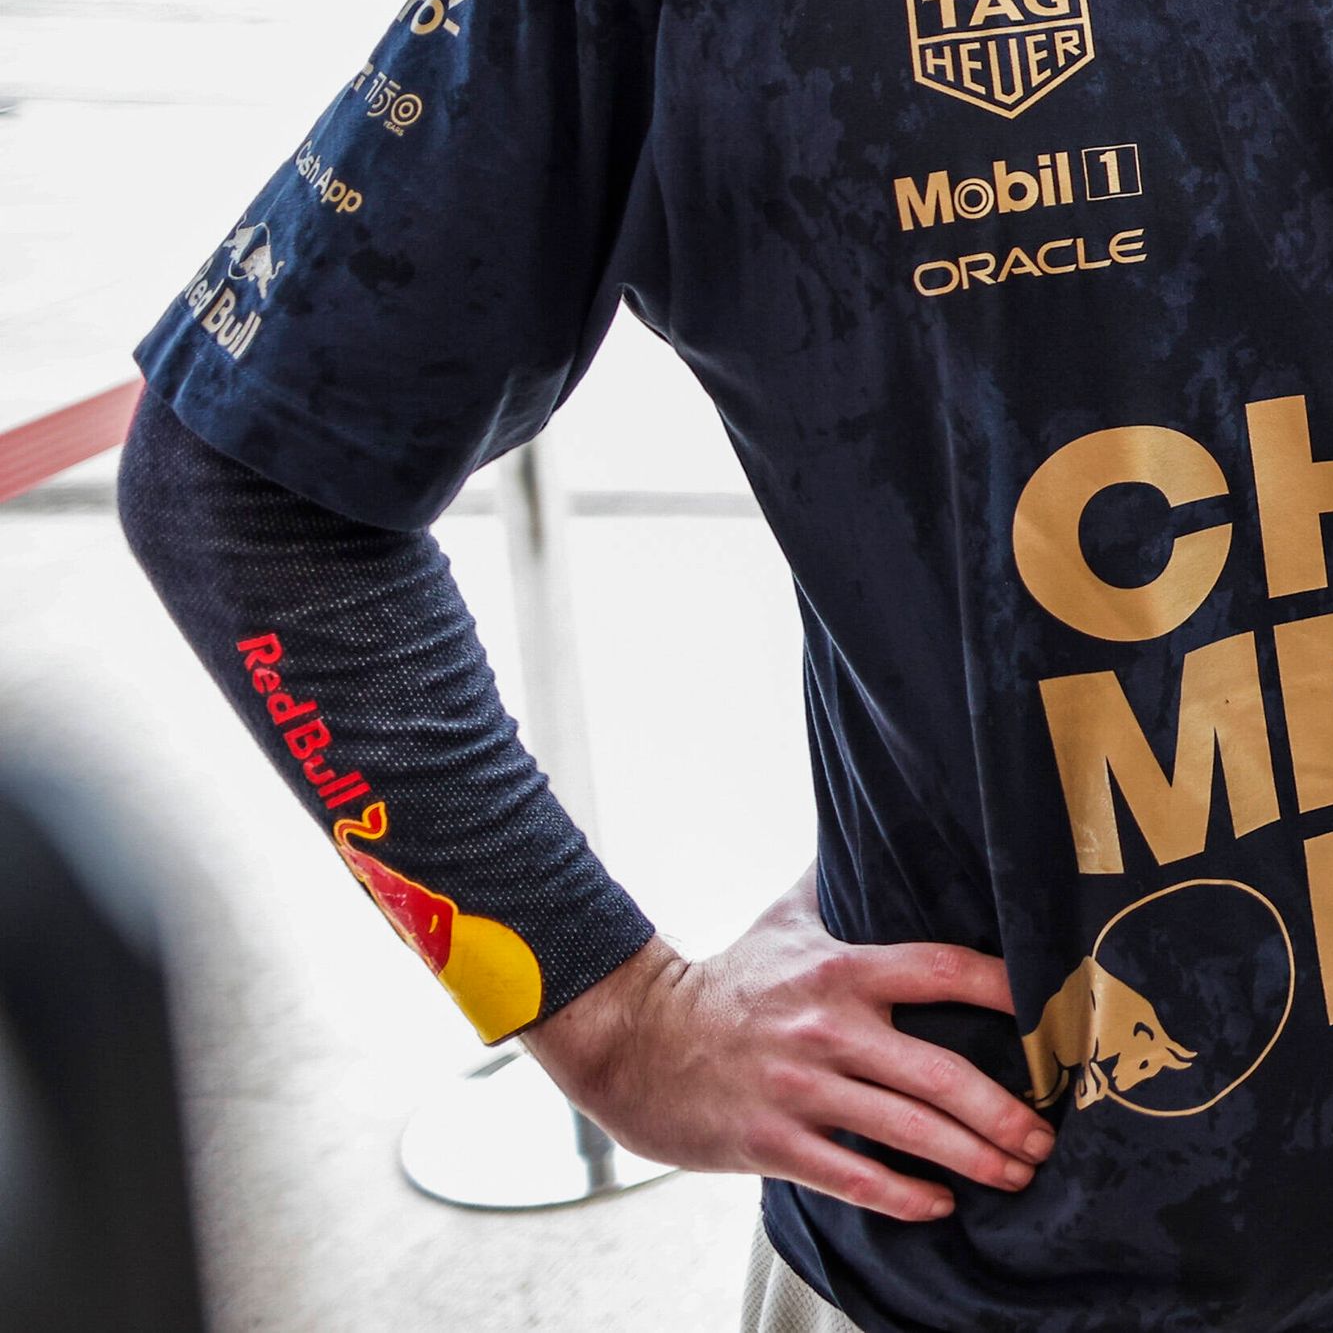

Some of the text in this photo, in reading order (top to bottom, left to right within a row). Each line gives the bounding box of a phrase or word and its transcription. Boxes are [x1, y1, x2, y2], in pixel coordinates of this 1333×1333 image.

[925, 29, 1082, 103] HEUER
[313, 166, 364, 213] App
[892, 148, 1121, 232] Mobil 1
[913, 227, 1148, 297] ORACLE
[201, 287, 262, 360] Bull
